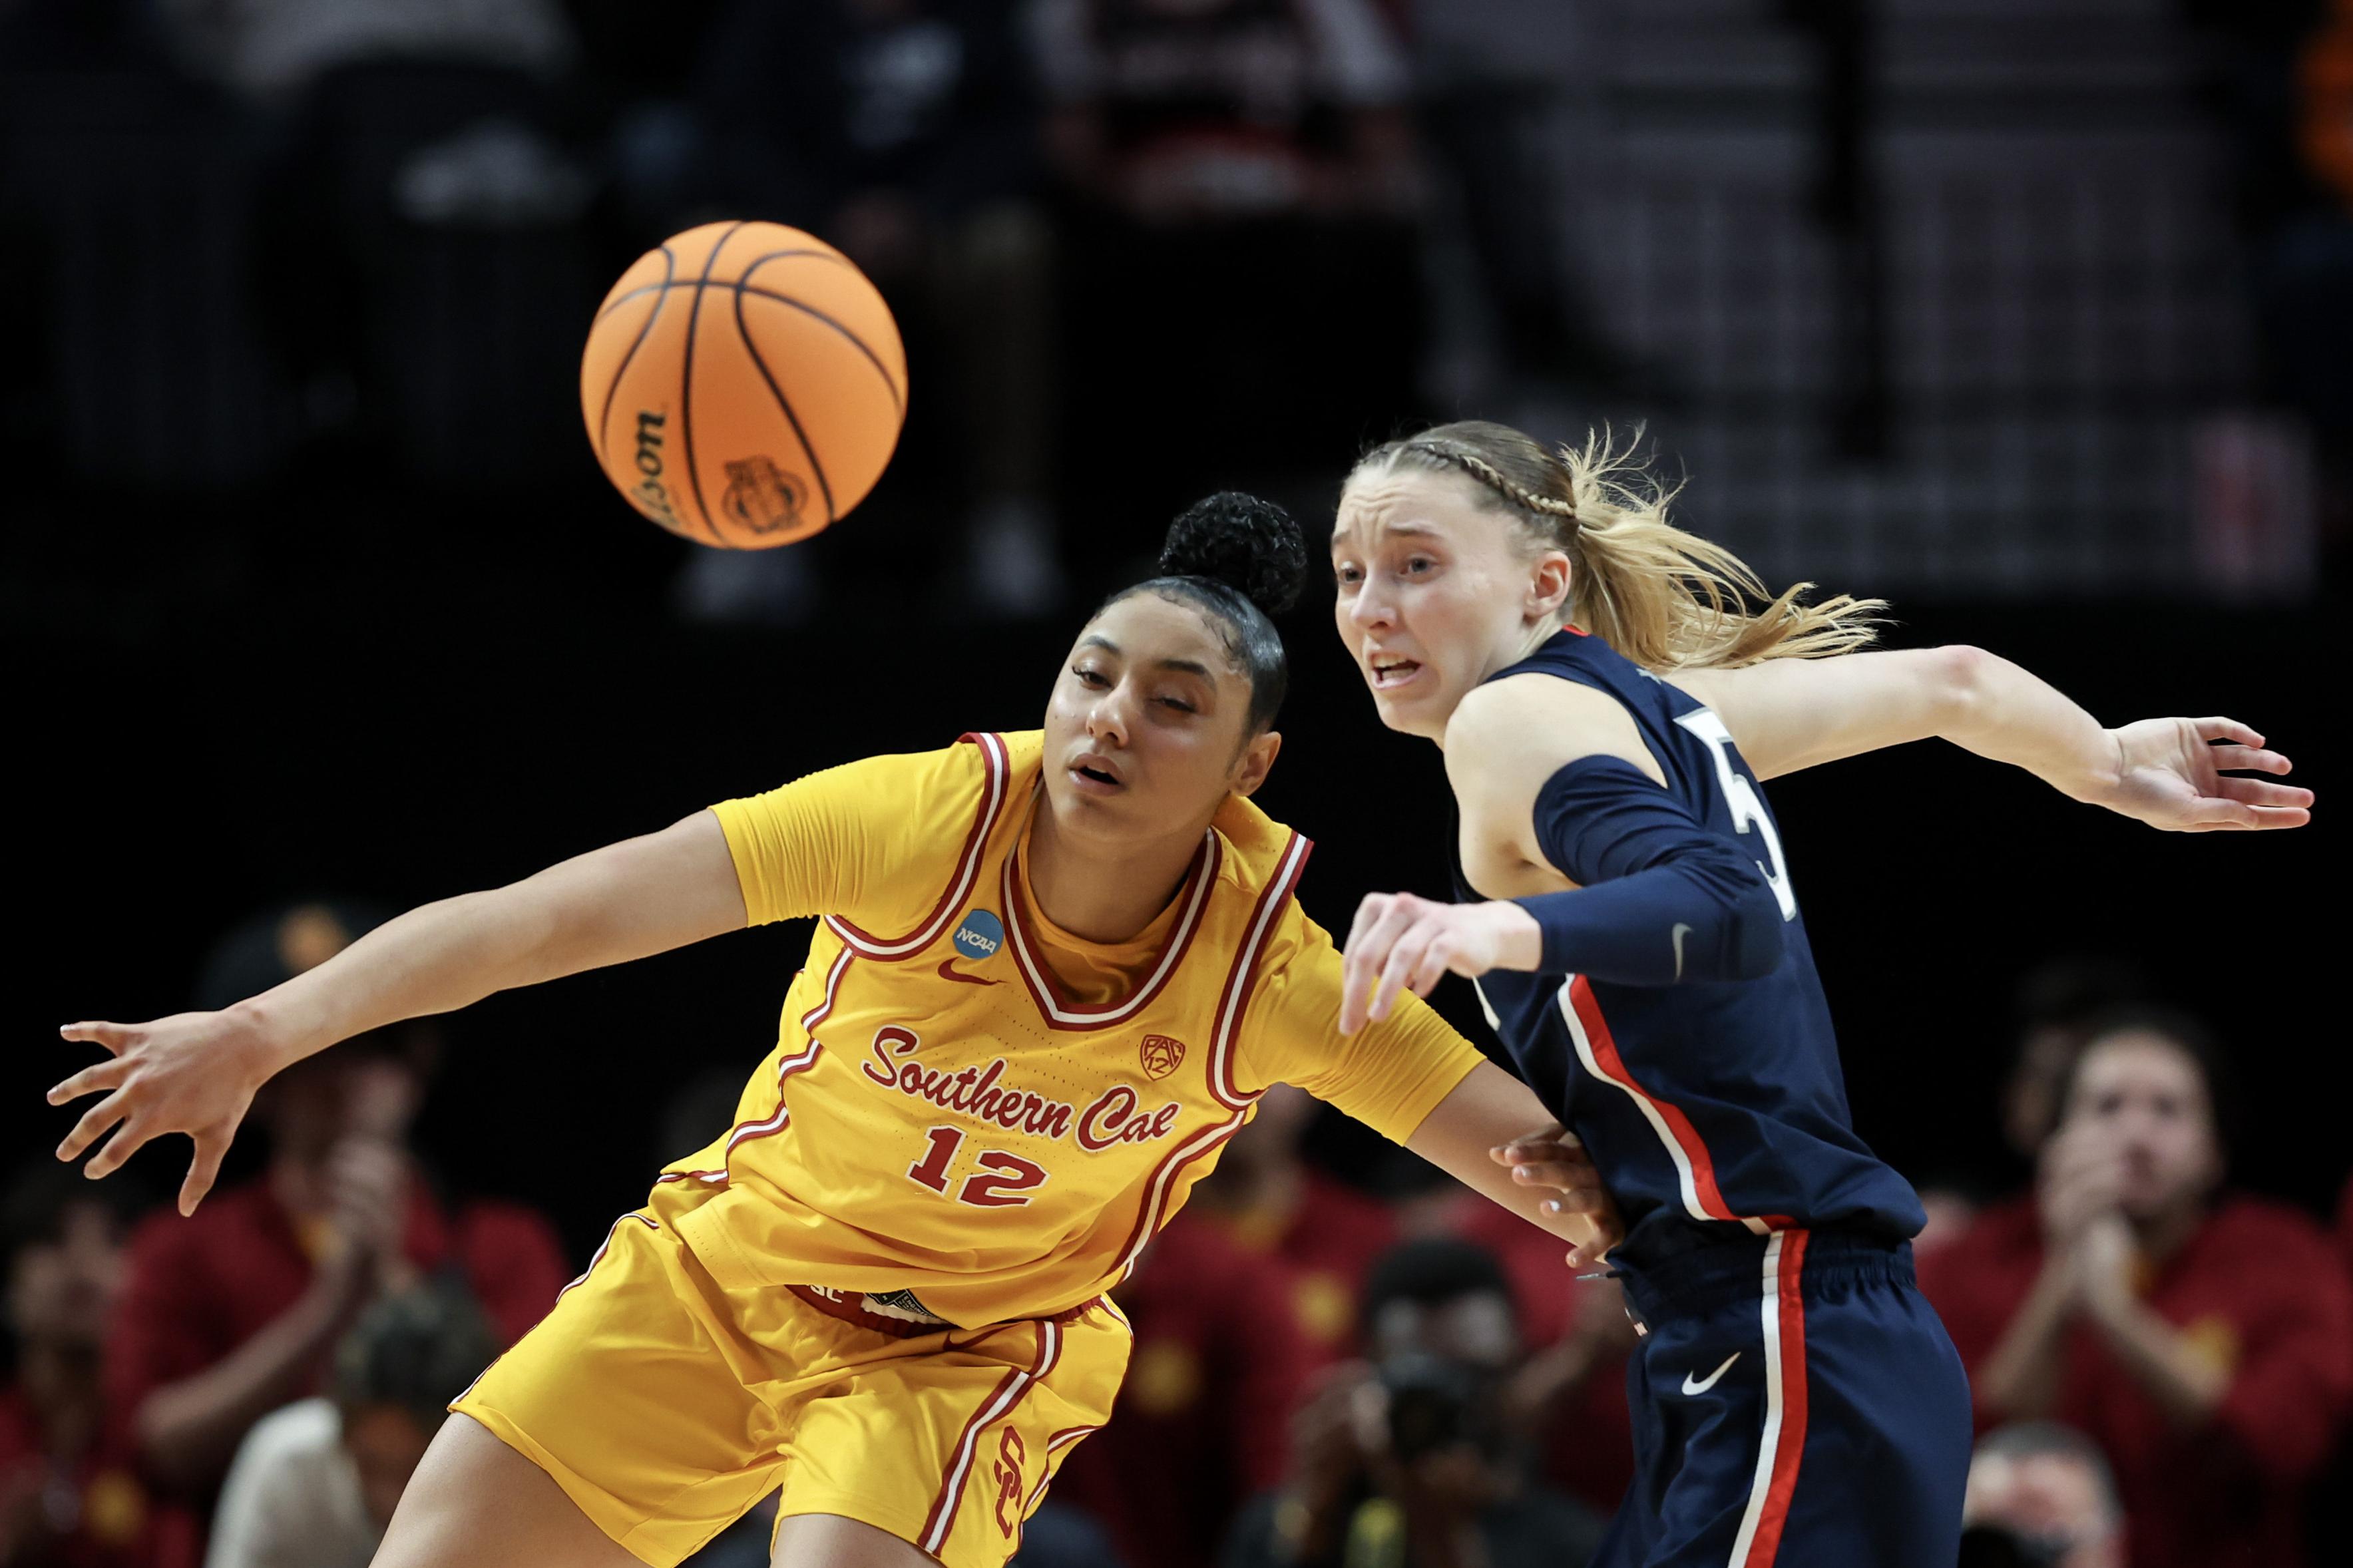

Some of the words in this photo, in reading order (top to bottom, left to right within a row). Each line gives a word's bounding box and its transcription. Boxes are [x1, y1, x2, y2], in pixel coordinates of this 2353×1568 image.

[1673, 706, 1797, 922] 5
[957, 927, 997, 954] NCAA
[1144, 1038, 1182, 1068] PAC
[1147, 1056, 1170, 1074] 12
[861, 1024, 1076, 1141] Southern
[1076, 1083, 1182, 1152] Cal
[905, 1123, 1050, 1207] 12
[806, 1284, 844, 1303] SC
[994, 1425, 1025, 1539] SC
